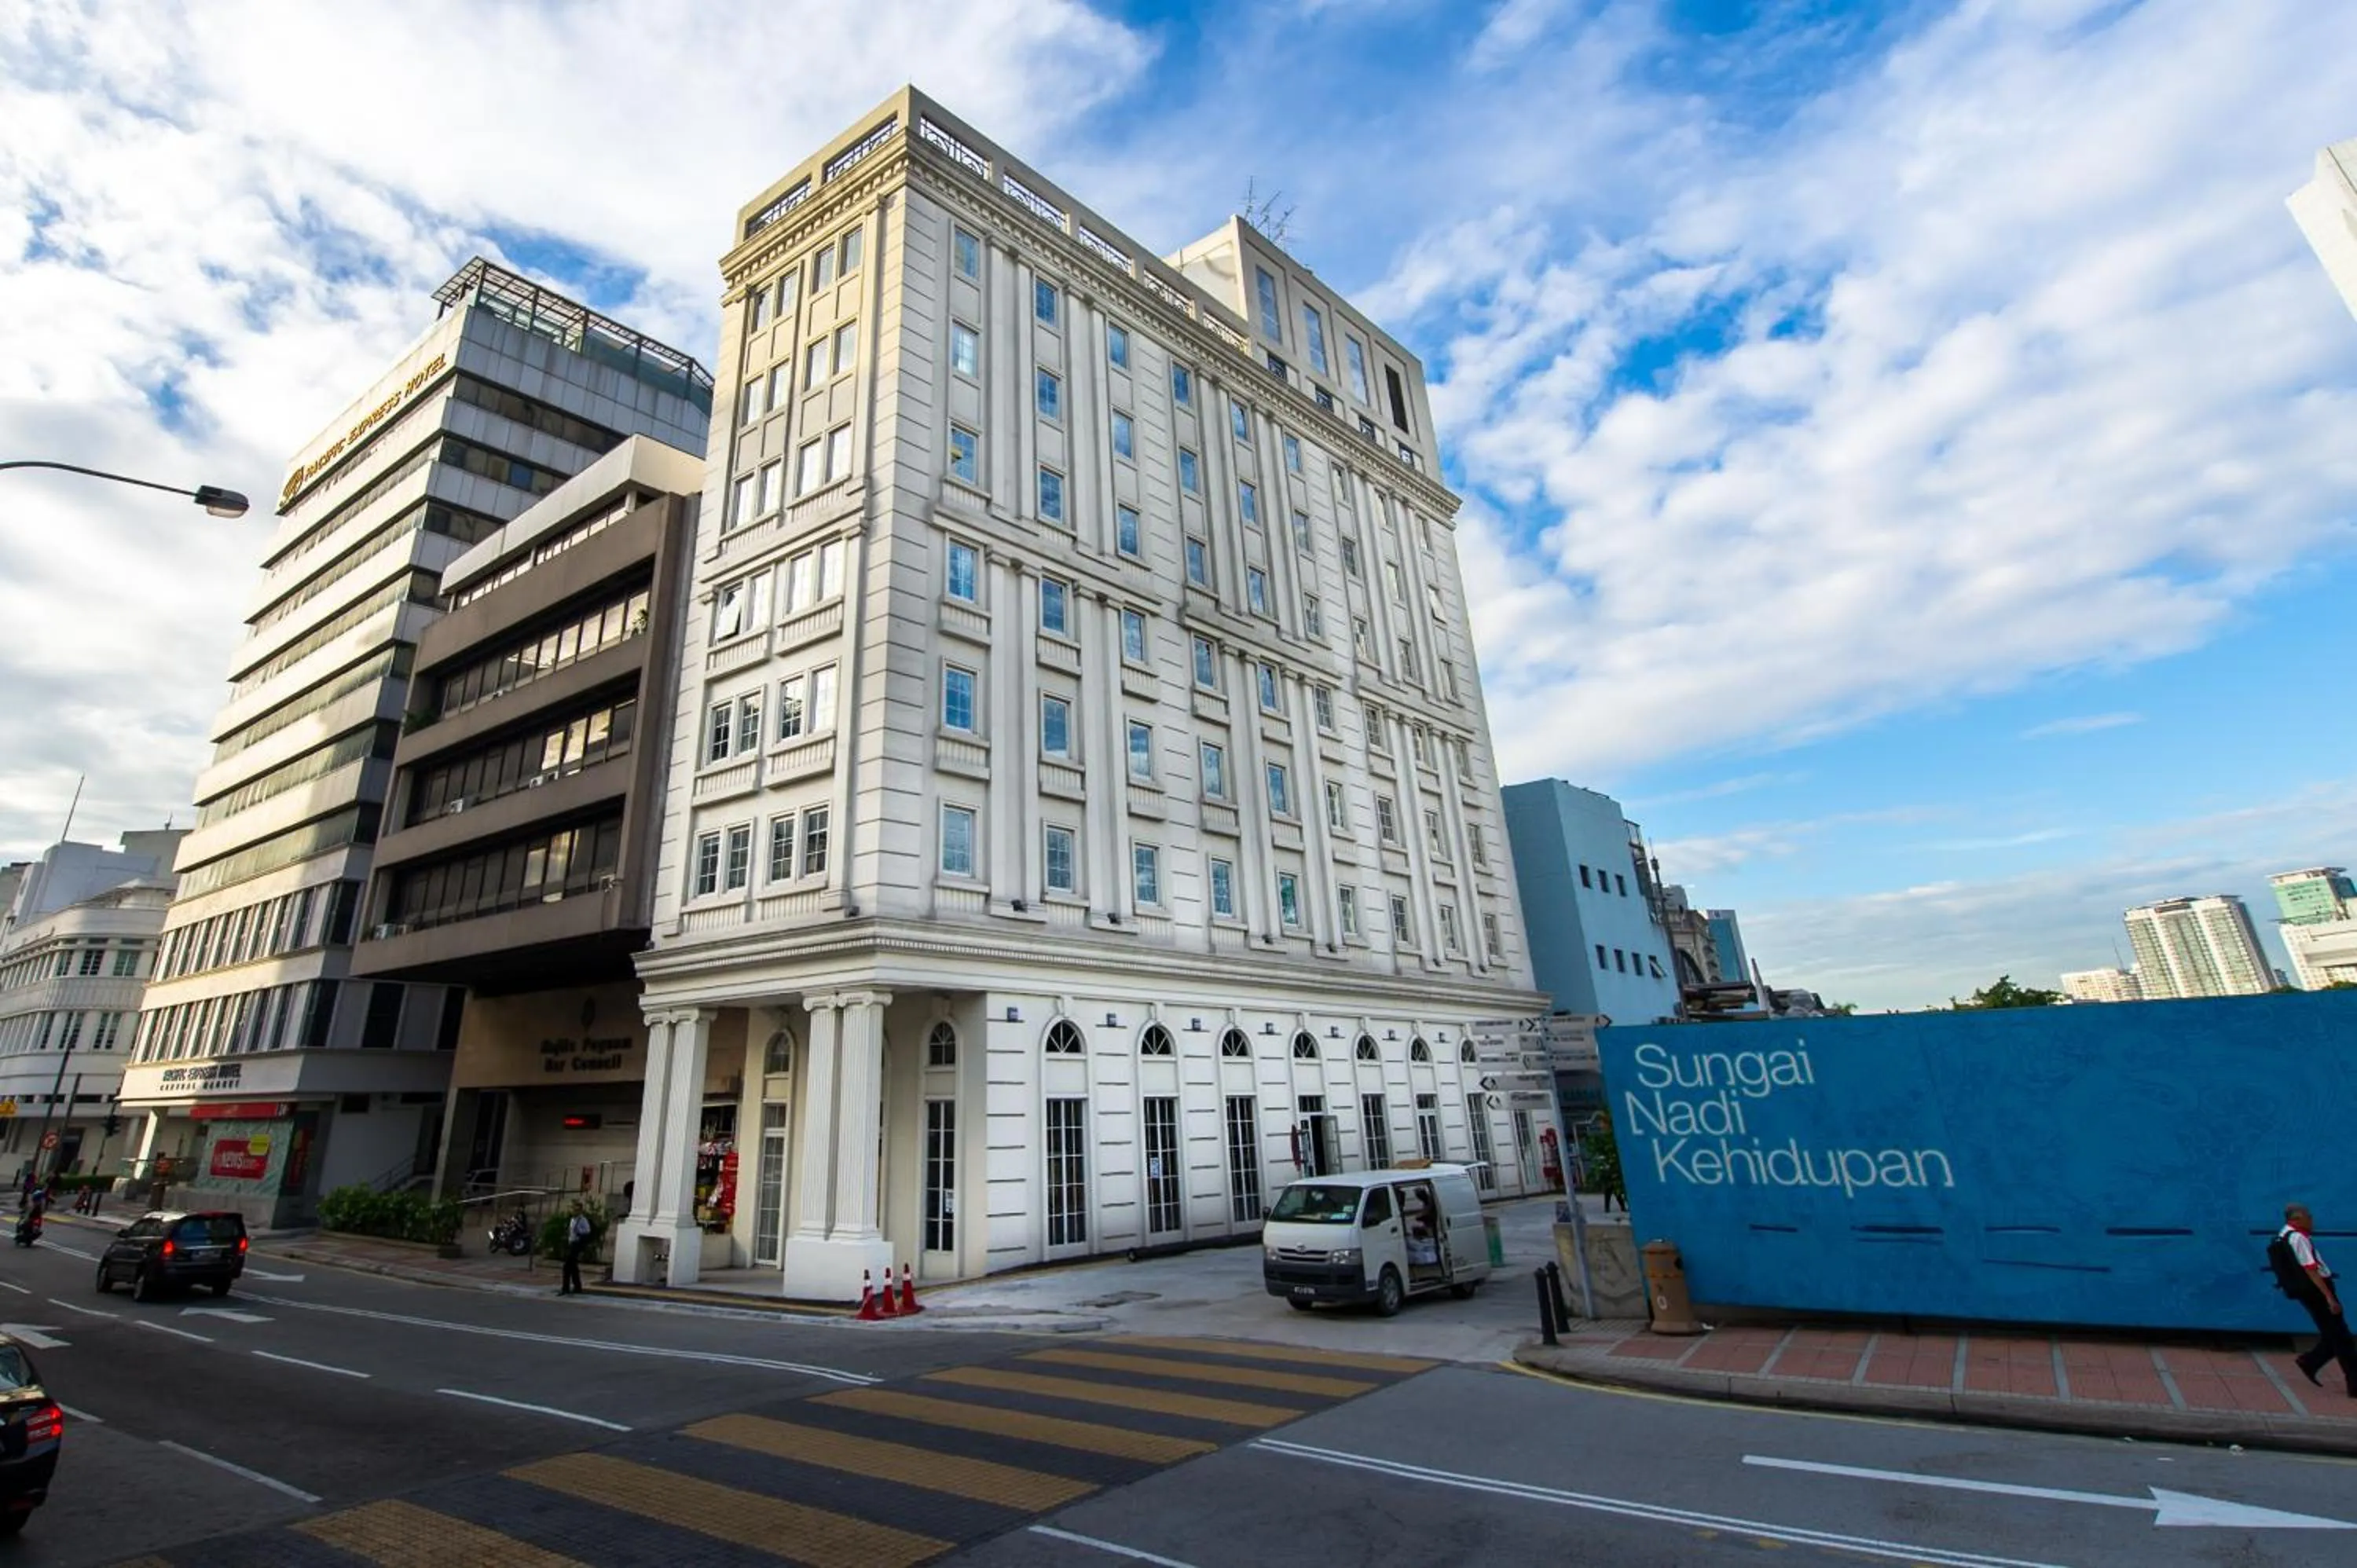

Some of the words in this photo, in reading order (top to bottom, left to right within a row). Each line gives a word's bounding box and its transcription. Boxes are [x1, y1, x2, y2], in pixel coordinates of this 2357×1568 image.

[1634, 1038, 1816, 1098] Sungai
[1624, 1089, 1747, 1136] Nadi
[1652, 1137, 1956, 1199] Kehidupan
